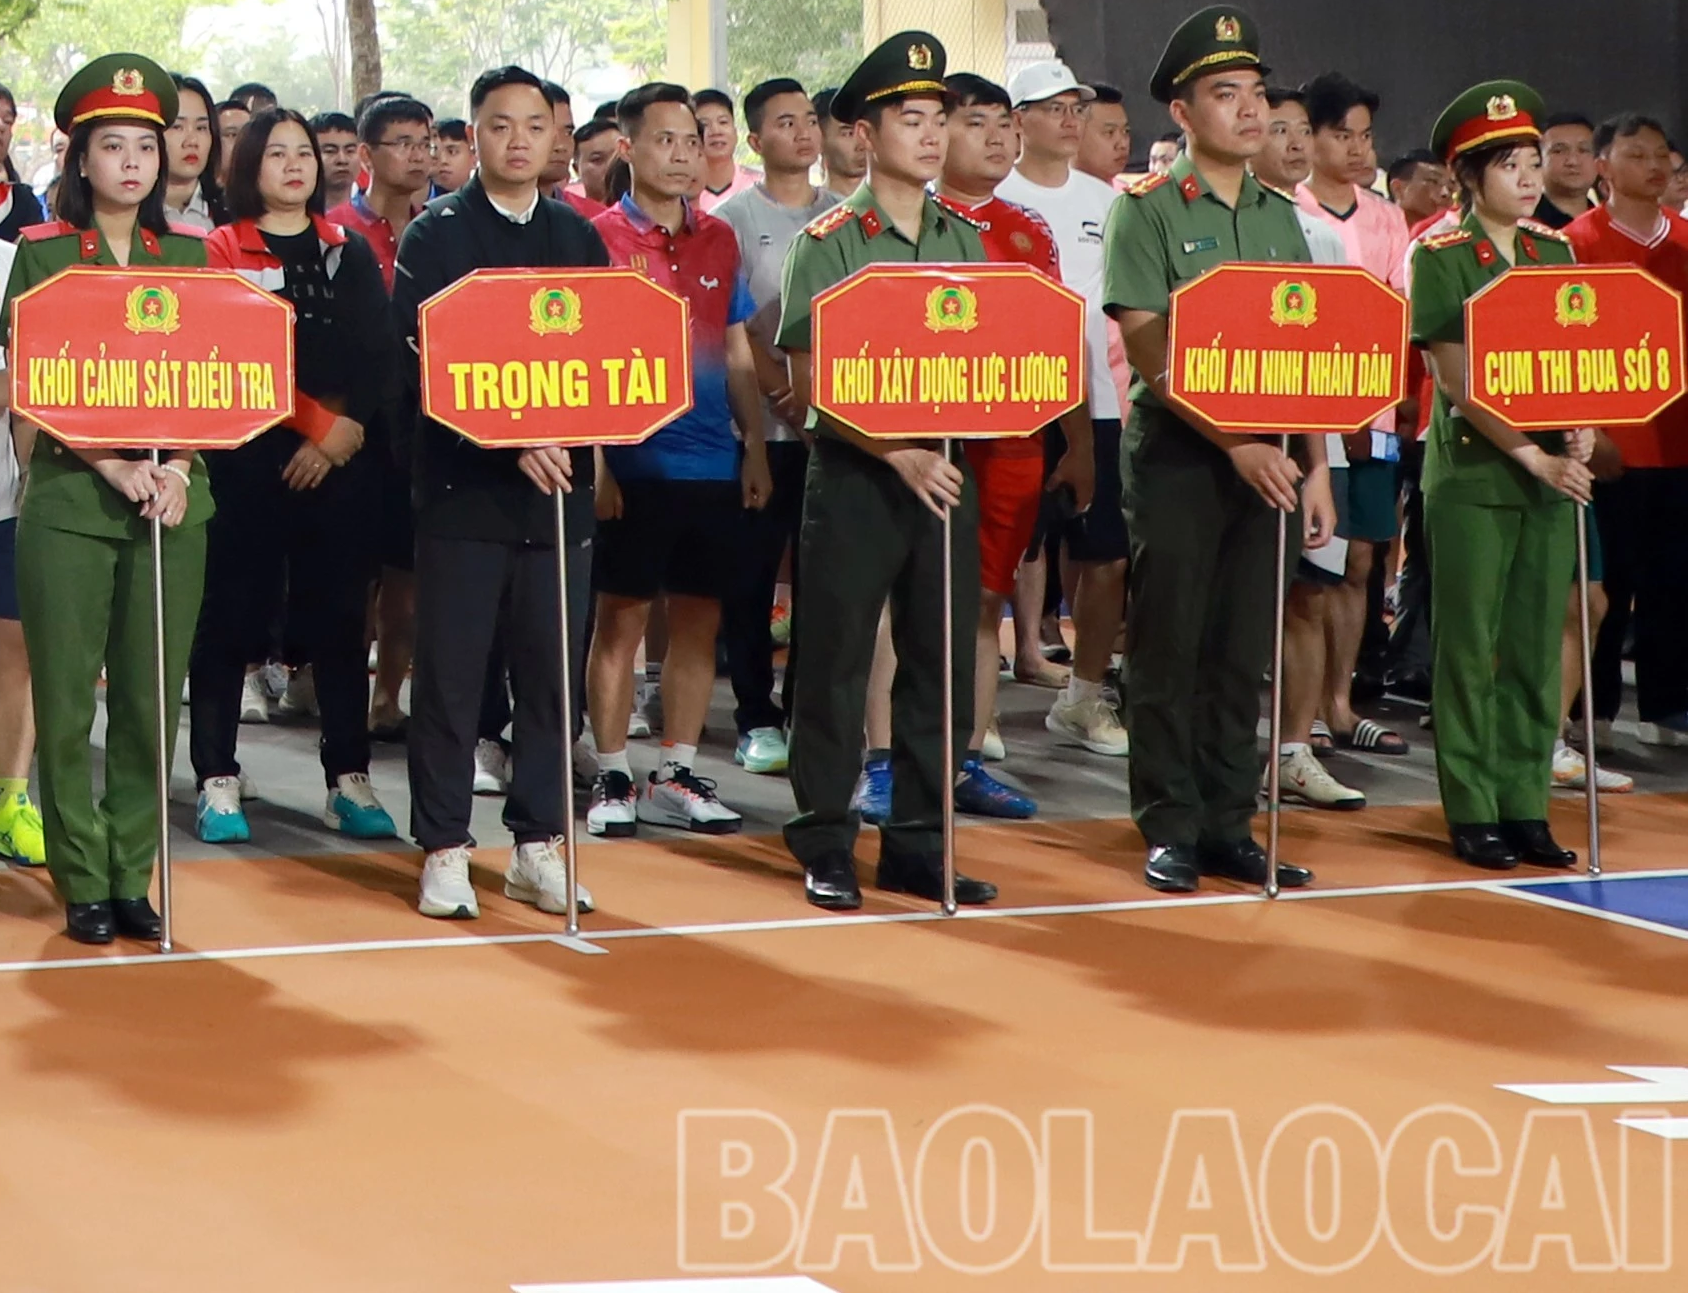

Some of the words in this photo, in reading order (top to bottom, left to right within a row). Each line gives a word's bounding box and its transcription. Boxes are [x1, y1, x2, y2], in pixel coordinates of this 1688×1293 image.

[29, 341, 78, 406] KHỐI
[82, 342, 139, 407] CẢNH
[144, 350, 183, 408] SÁT
[186, 346, 234, 409] ĐIỀU
[237, 362, 277, 409] TRA
[447, 359, 591, 421] TRỌNG
[601, 347, 668, 406] TÀI
[832, 341, 876, 404] KHỐI
[879, 347, 915, 403] XÂY
[919, 352, 969, 413] DỰNG
[972, 352, 1007, 412] LỰC
[1010, 352, 1069, 412] LƯỢNG
[1184, 332, 1227, 393] KHỐI
[1230, 349, 1257, 394] AN
[1260, 351, 1304, 395] NINH
[1307, 341, 1355, 396] NHÂN
[1358, 346, 1393, 397] DÂN
[1485, 351, 1535, 405] CỤM
[1538, 350, 1573, 393] THI
[1577, 349, 1620, 393] ĐUA
[1624, 332, 1653, 392] SỐ
[1657, 348, 1671, 391] 8
